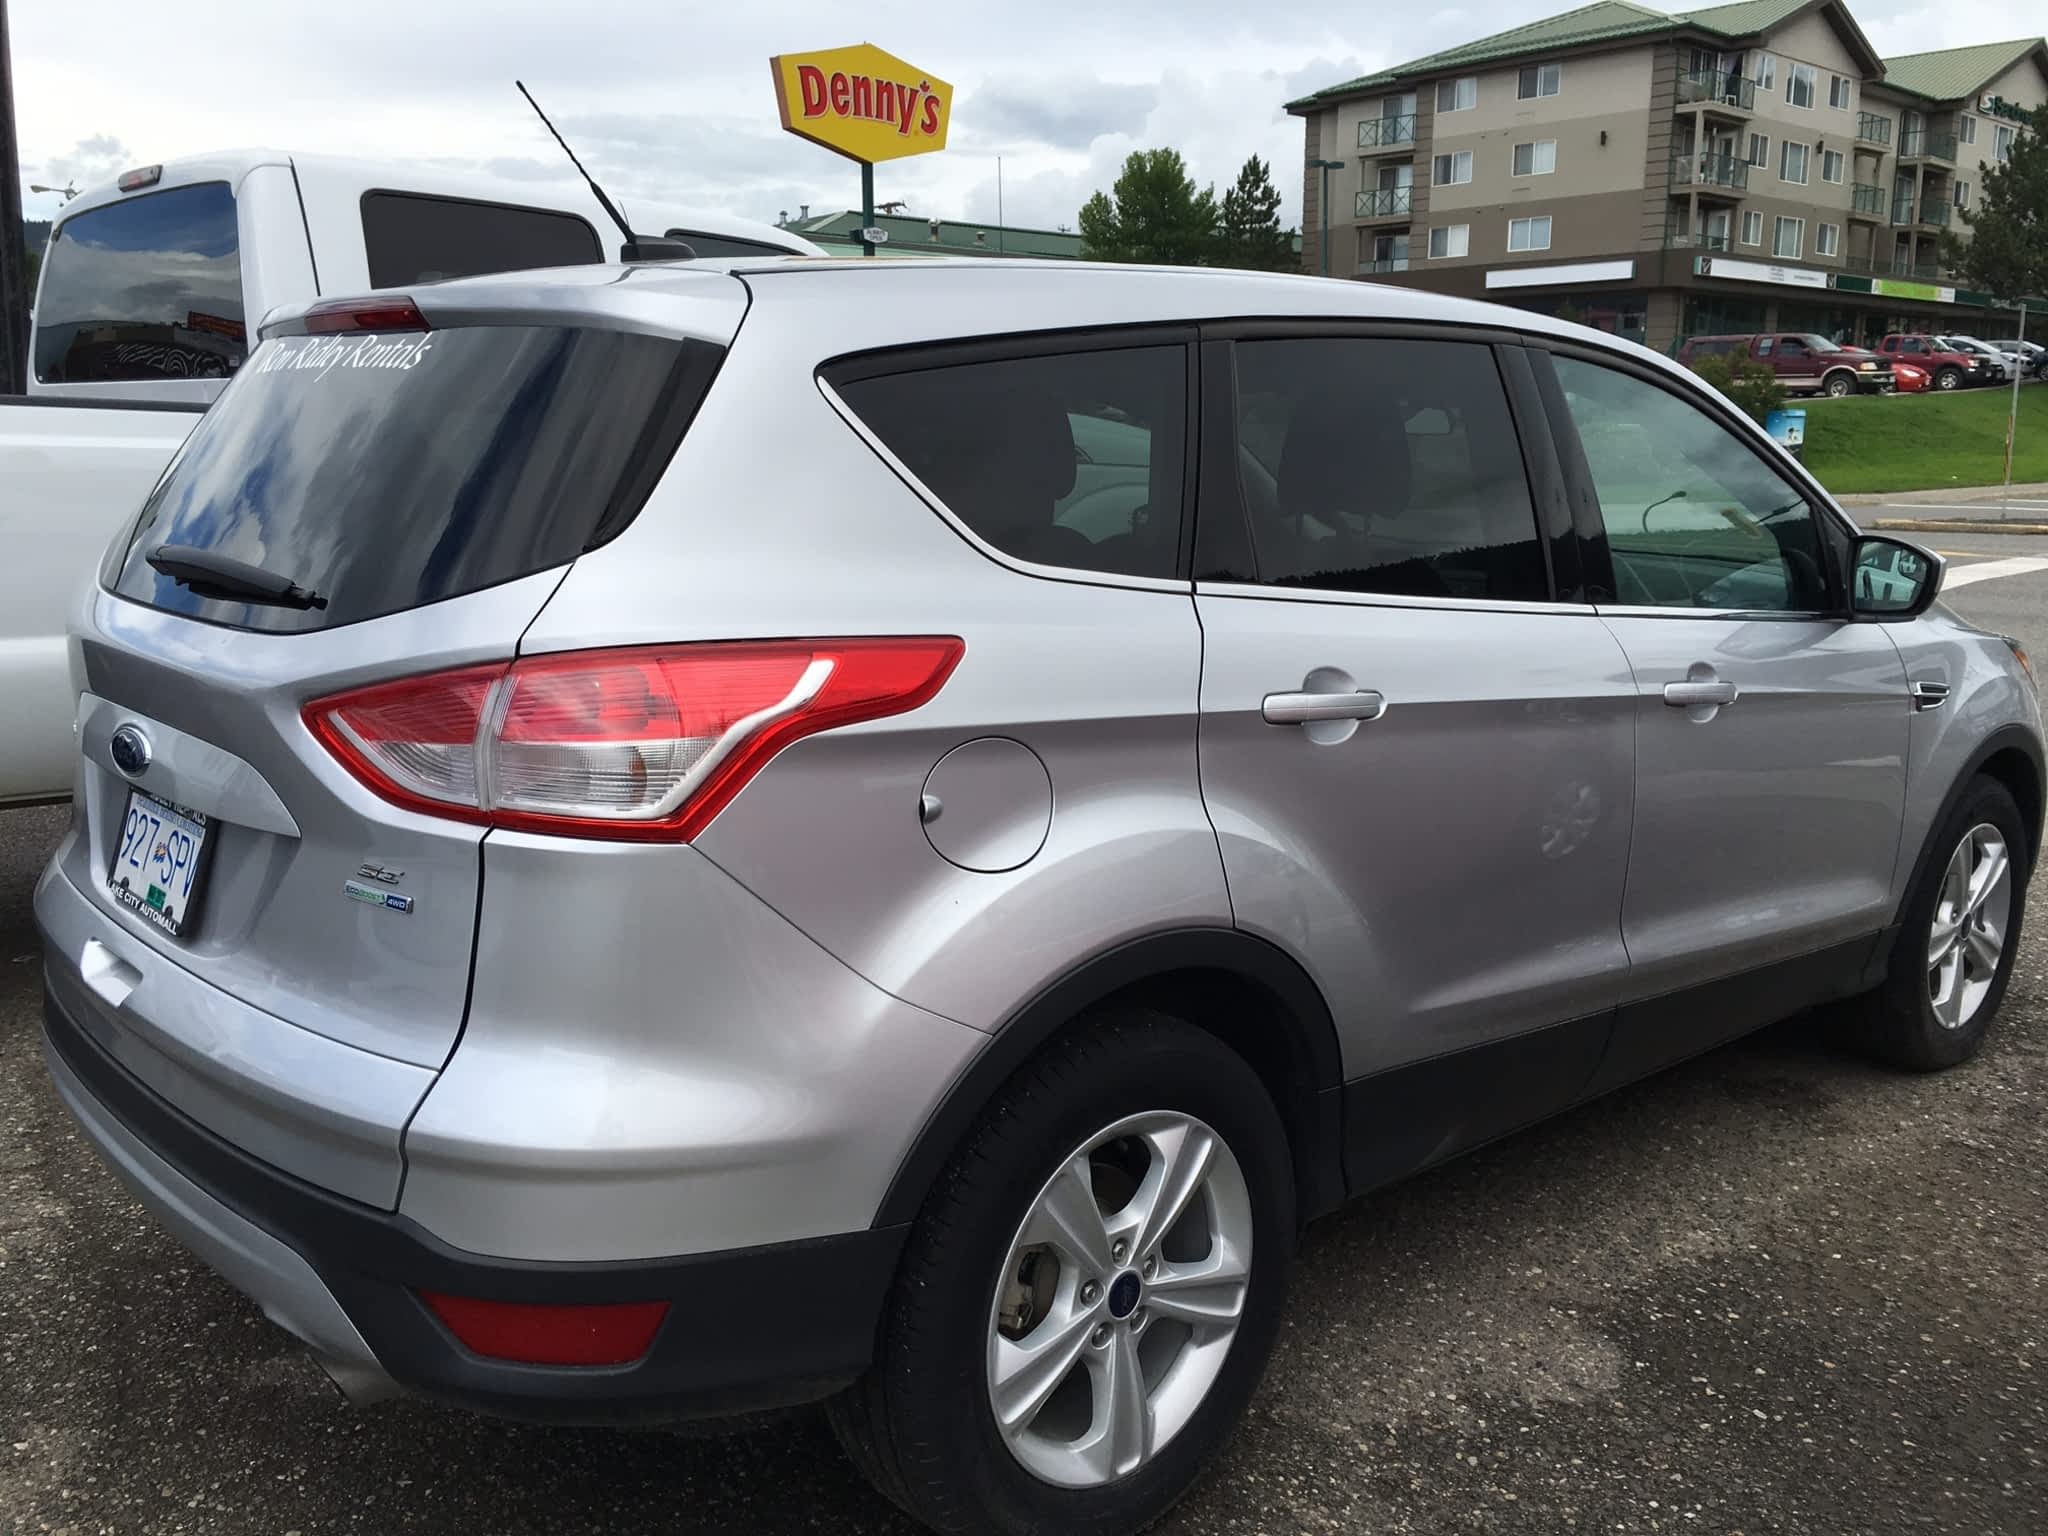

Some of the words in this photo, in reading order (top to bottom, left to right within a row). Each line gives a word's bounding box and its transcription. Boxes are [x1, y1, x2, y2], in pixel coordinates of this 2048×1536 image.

[797, 65, 940, 136] Denny's
[343, 332, 432, 369] Rentals
[121, 808, 160, 872] 927
[161, 830, 198, 898] SPV
[124, 891, 140, 909] CITY
[139, 903, 177, 935] AUTOMALL
